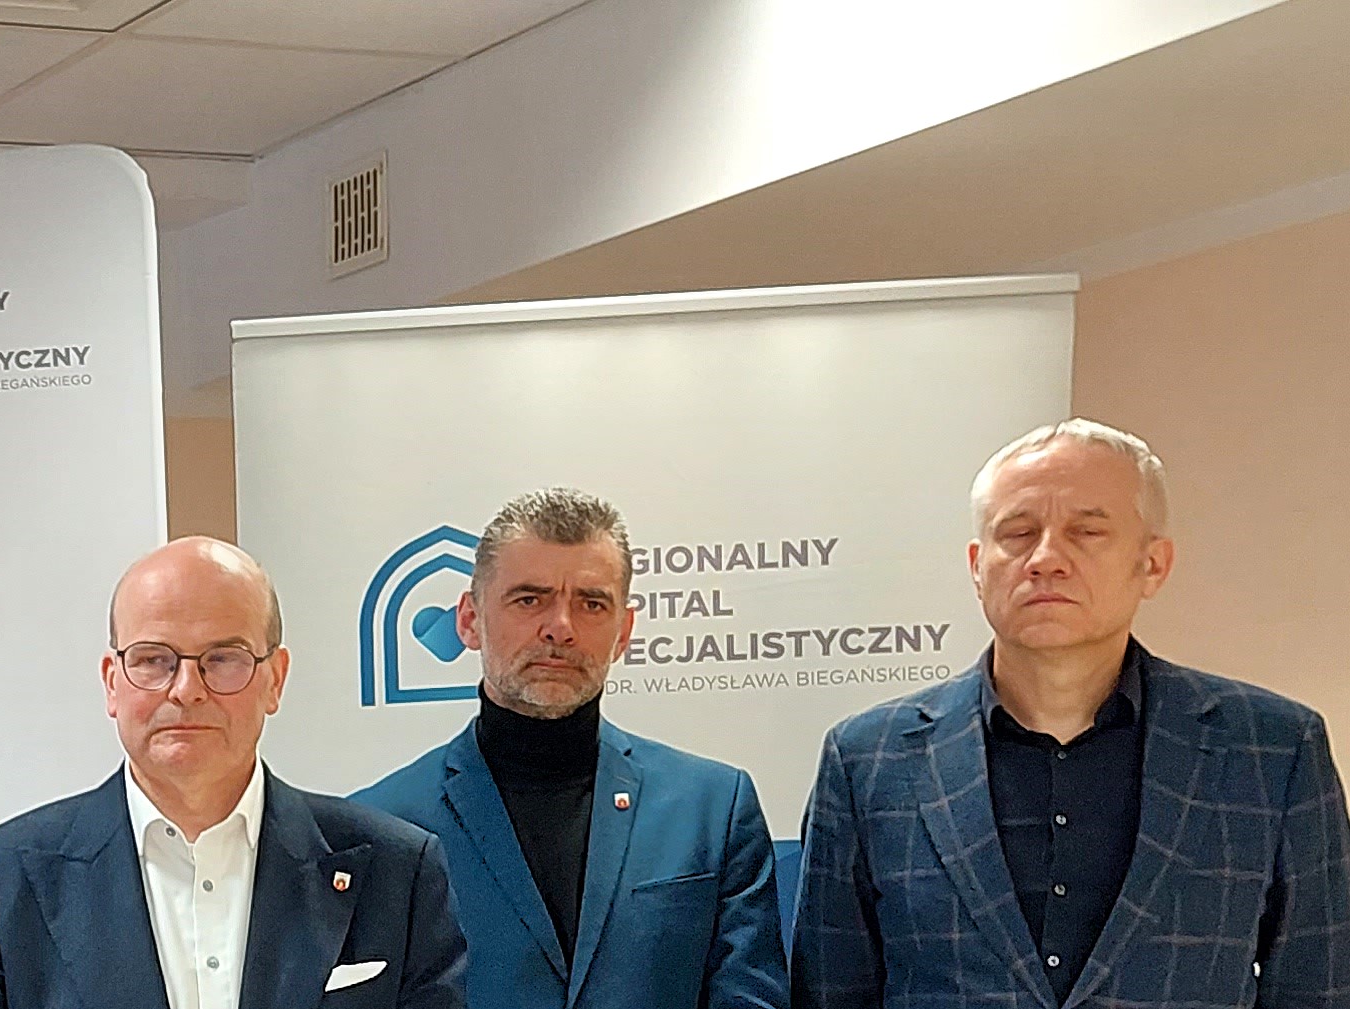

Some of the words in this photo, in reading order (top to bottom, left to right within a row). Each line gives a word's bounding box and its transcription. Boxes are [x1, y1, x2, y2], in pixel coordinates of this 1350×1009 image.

[632, 537, 839, 576] GIONALNY
[624, 623, 951, 666] ECJALISTYCZNY
[605, 679, 638, 696] DR.
[644, 671, 790, 693] WŁADYSŁAWA
[796, 664, 951, 688] BIEGAŃSKIEGO
